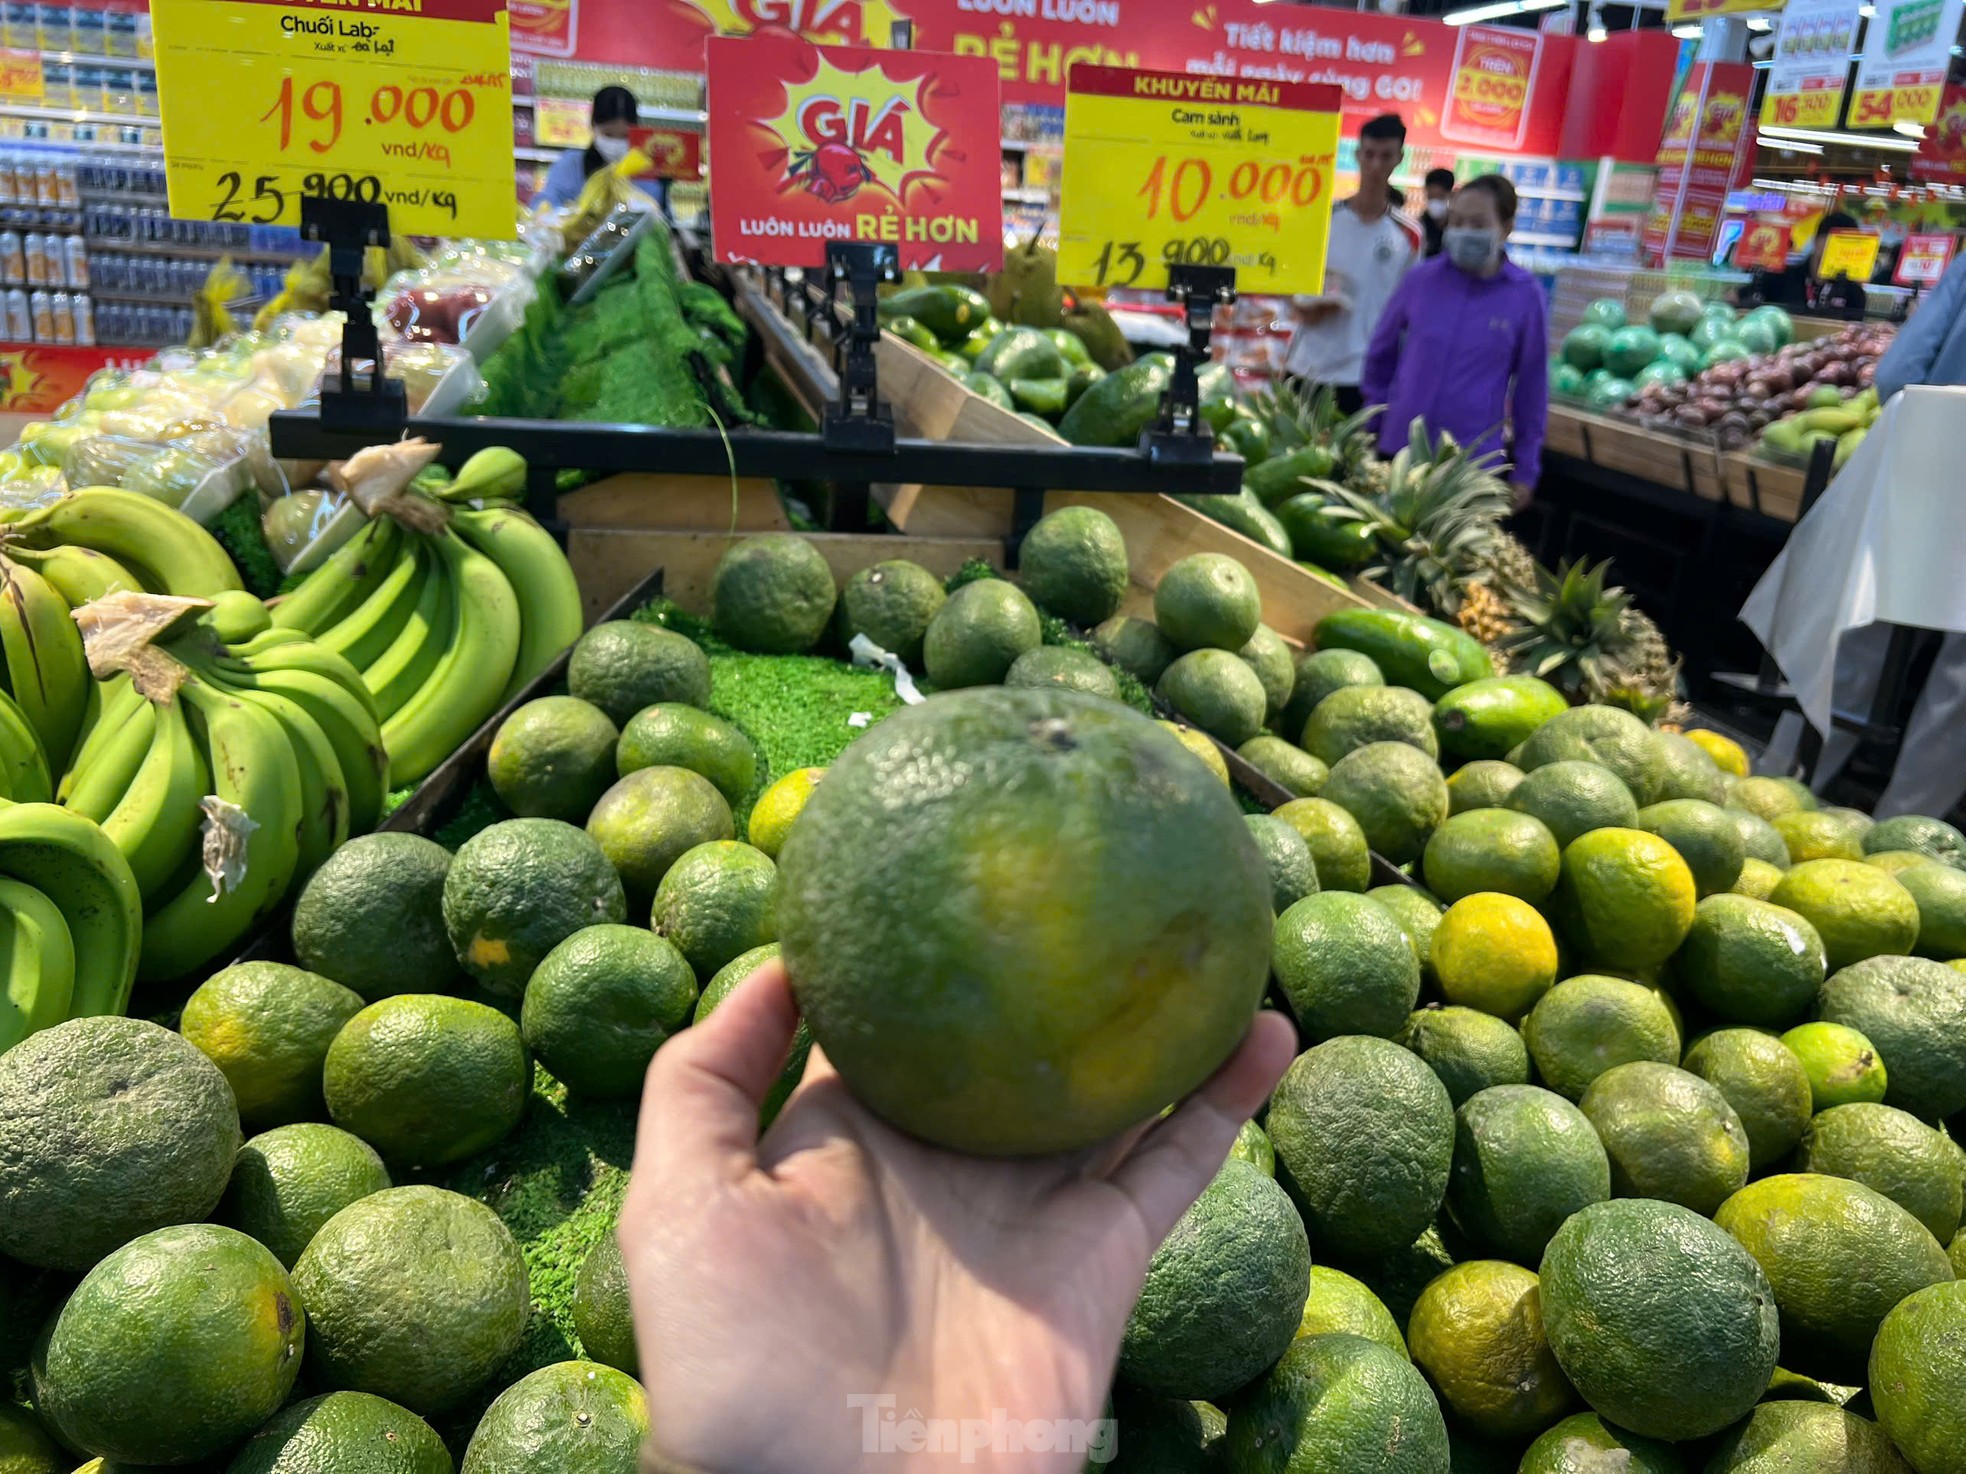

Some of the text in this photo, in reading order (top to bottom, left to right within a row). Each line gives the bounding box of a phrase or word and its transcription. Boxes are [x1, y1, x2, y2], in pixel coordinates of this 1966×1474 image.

[281, 15, 380, 38] Chuối Lab
[1134, 75, 1232, 101] KHUYẾN
[1375, 73, 1423, 103] GO!
[797, 94, 912, 165] GIÁ
[1171, 108, 1240, 127] Cam sành
[739, 205, 978, 244] LUÔN LUÔN RẺ HƠN
